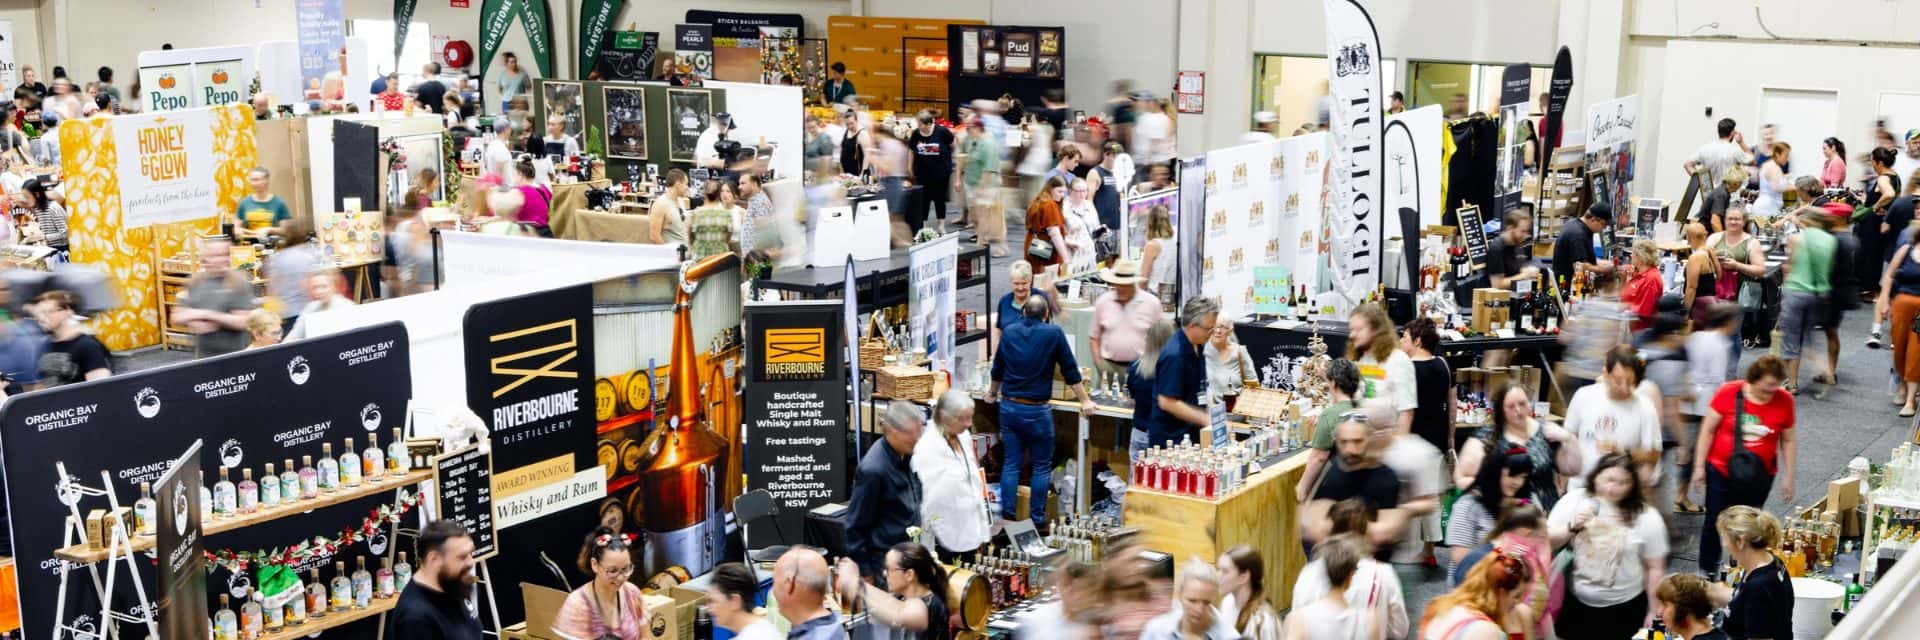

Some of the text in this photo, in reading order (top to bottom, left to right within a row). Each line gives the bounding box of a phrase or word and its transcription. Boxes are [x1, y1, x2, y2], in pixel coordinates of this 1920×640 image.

[585, 1, 612, 57] CLAYSTONE
[1008, 42, 1030, 53] Pud
[151, 91, 187, 111] Pepo
[205, 86, 239, 106] Pepo
[138, 125, 184, 154] HONEY
[1351, 88, 1370, 276] TULLOCH
[339, 340, 394, 360] ORGANIC BAY
[348, 350, 387, 366] DISTILLERY
[766, 362, 825, 375] RIVERBOURNE
[194, 372, 256, 393] ORGANIC BAY
[205, 383, 249, 399] DISTILLERY
[767, 400, 824, 409] handcrafted
[774, 392, 817, 401] Boutique
[25, 403, 98, 426] ORGANIC BAY
[493, 388, 579, 432] RIVERBOURNE
[769, 409, 822, 419] Single Malt
[38, 415, 89, 432] DISTILLERY
[274, 420, 332, 442] ORGANIC BAY
[503, 419, 573, 445] DISTILLERY
[756, 418, 835, 429] Whisky and Rum
[283, 431, 325, 448] DISTILLERY
[766, 436, 827, 447] Free tastings
[761, 462, 831, 473] fermented and
[776, 454, 816, 464] Mashed,
[119, 461, 165, 479] ORGANIC
[496, 462, 570, 493] AWARD WINNING
[778, 473, 814, 483] aged at
[768, 482, 825, 491] Riverbourne
[768, 490, 833, 499] APTAINS FLAT
[497, 480, 598, 520] Whisky and Rum
[784, 499, 808, 507] NSW
